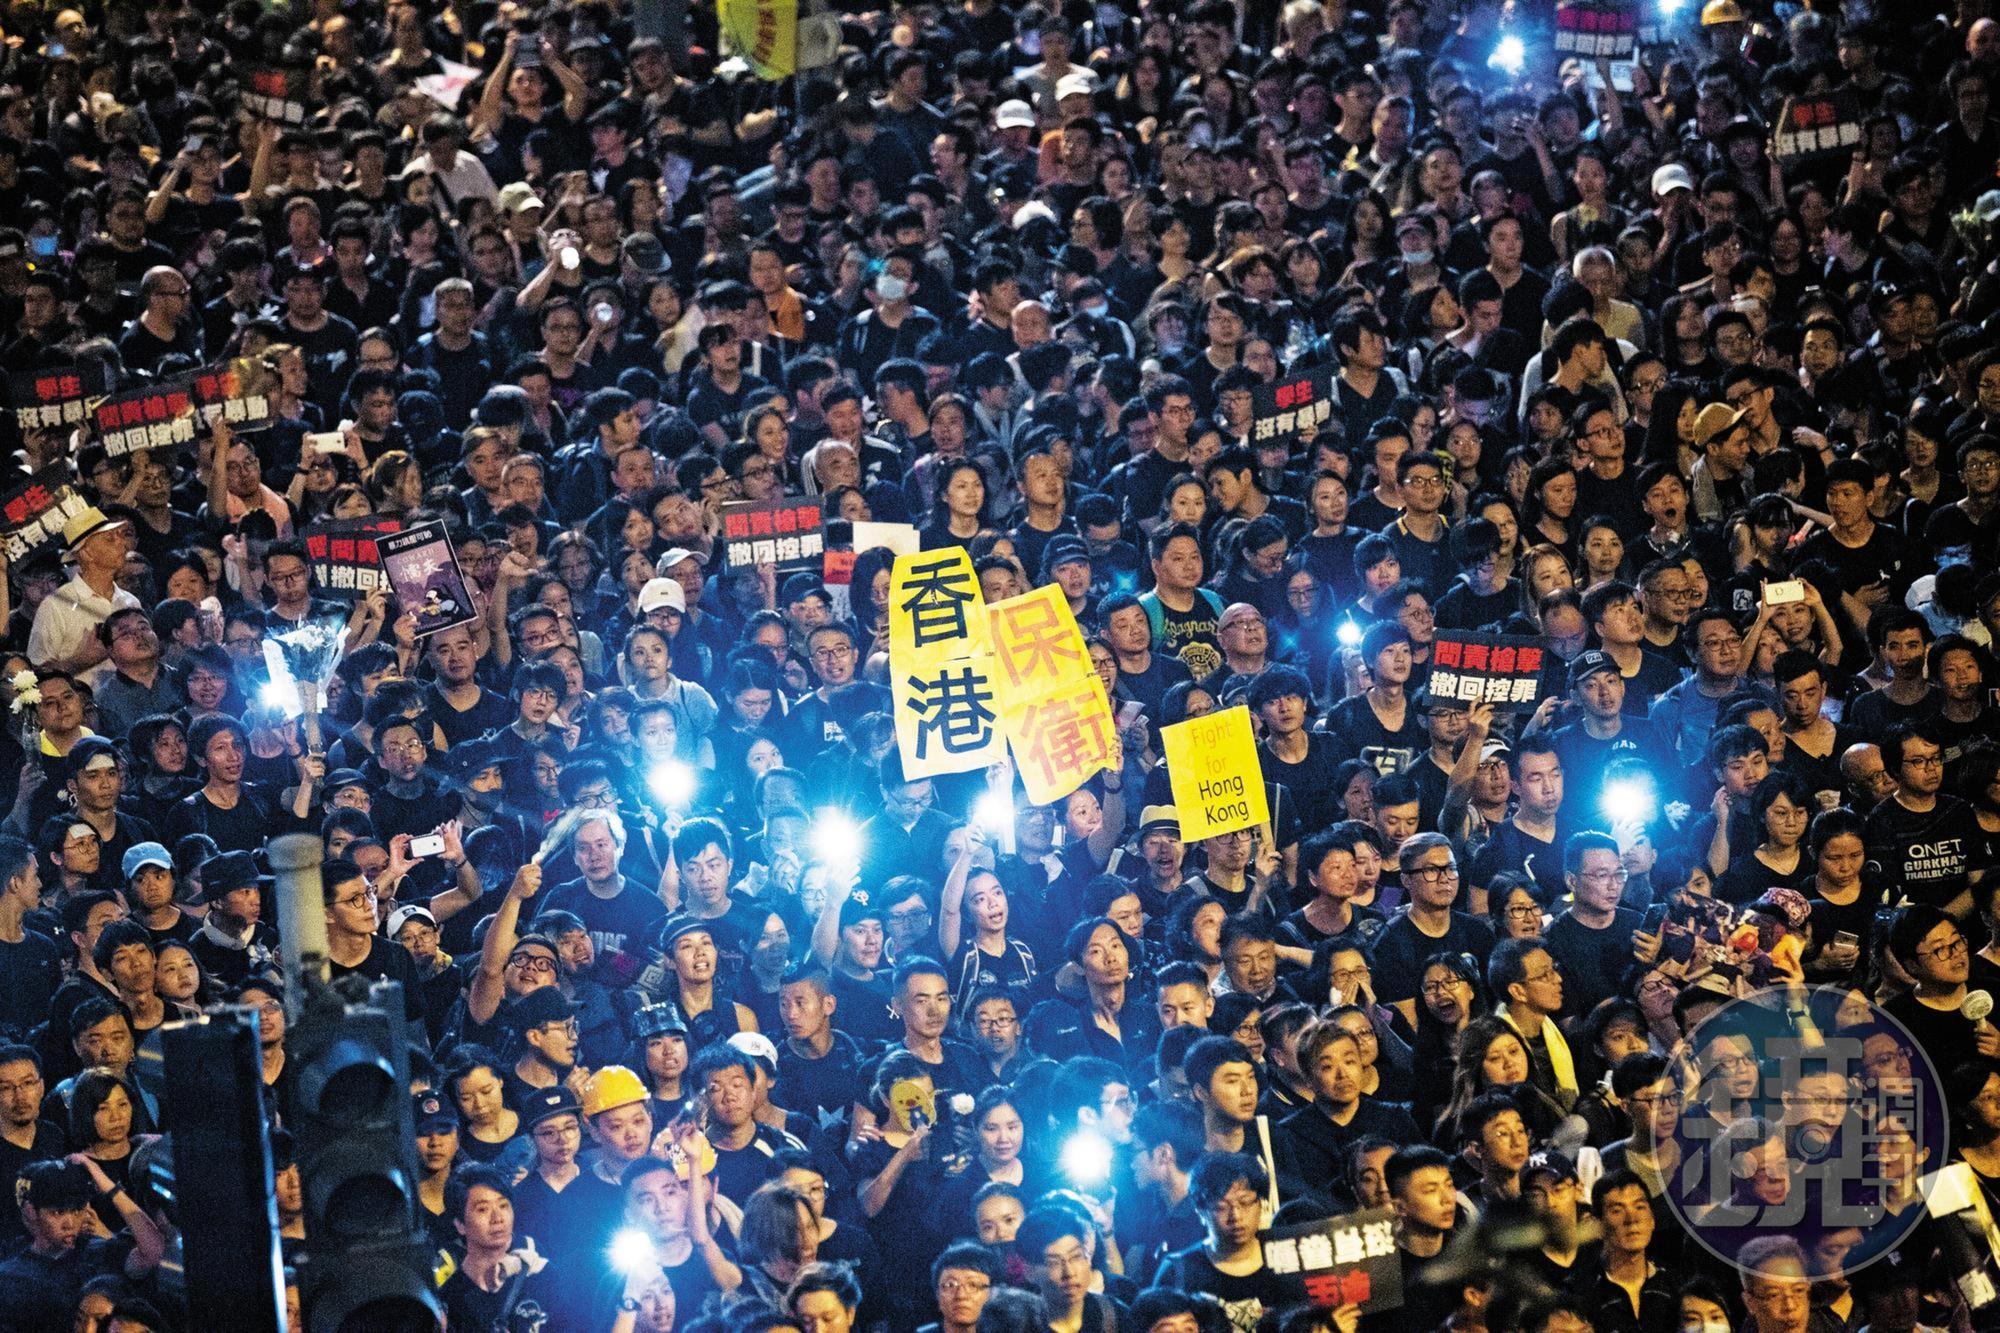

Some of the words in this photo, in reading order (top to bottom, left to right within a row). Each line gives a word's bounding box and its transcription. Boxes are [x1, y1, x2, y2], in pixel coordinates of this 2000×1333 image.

[36, 376, 80, 400] 學生
[1276, 381, 1313, 409] 學生
[103, 419, 195, 457] 撤回控罪
[4, 484, 54, 524] 學生
[725, 505, 821, 538] 問責槍擊
[728, 533, 823, 567] 撤回控罪
[901, 557, 996, 761] 香港
[1434, 640, 1544, 673] 問責槍擊
[990, 596, 1108, 787] 保衛
[1429, 671, 1538, 703] 撤回控罪
[1191, 721, 1233, 750] Fight
[1206, 756, 1228, 776] for
[1198, 775, 1245, 801] Hong
[1204, 801, 1250, 826] Kong
[1908, 838, 1962, 858] QNET
